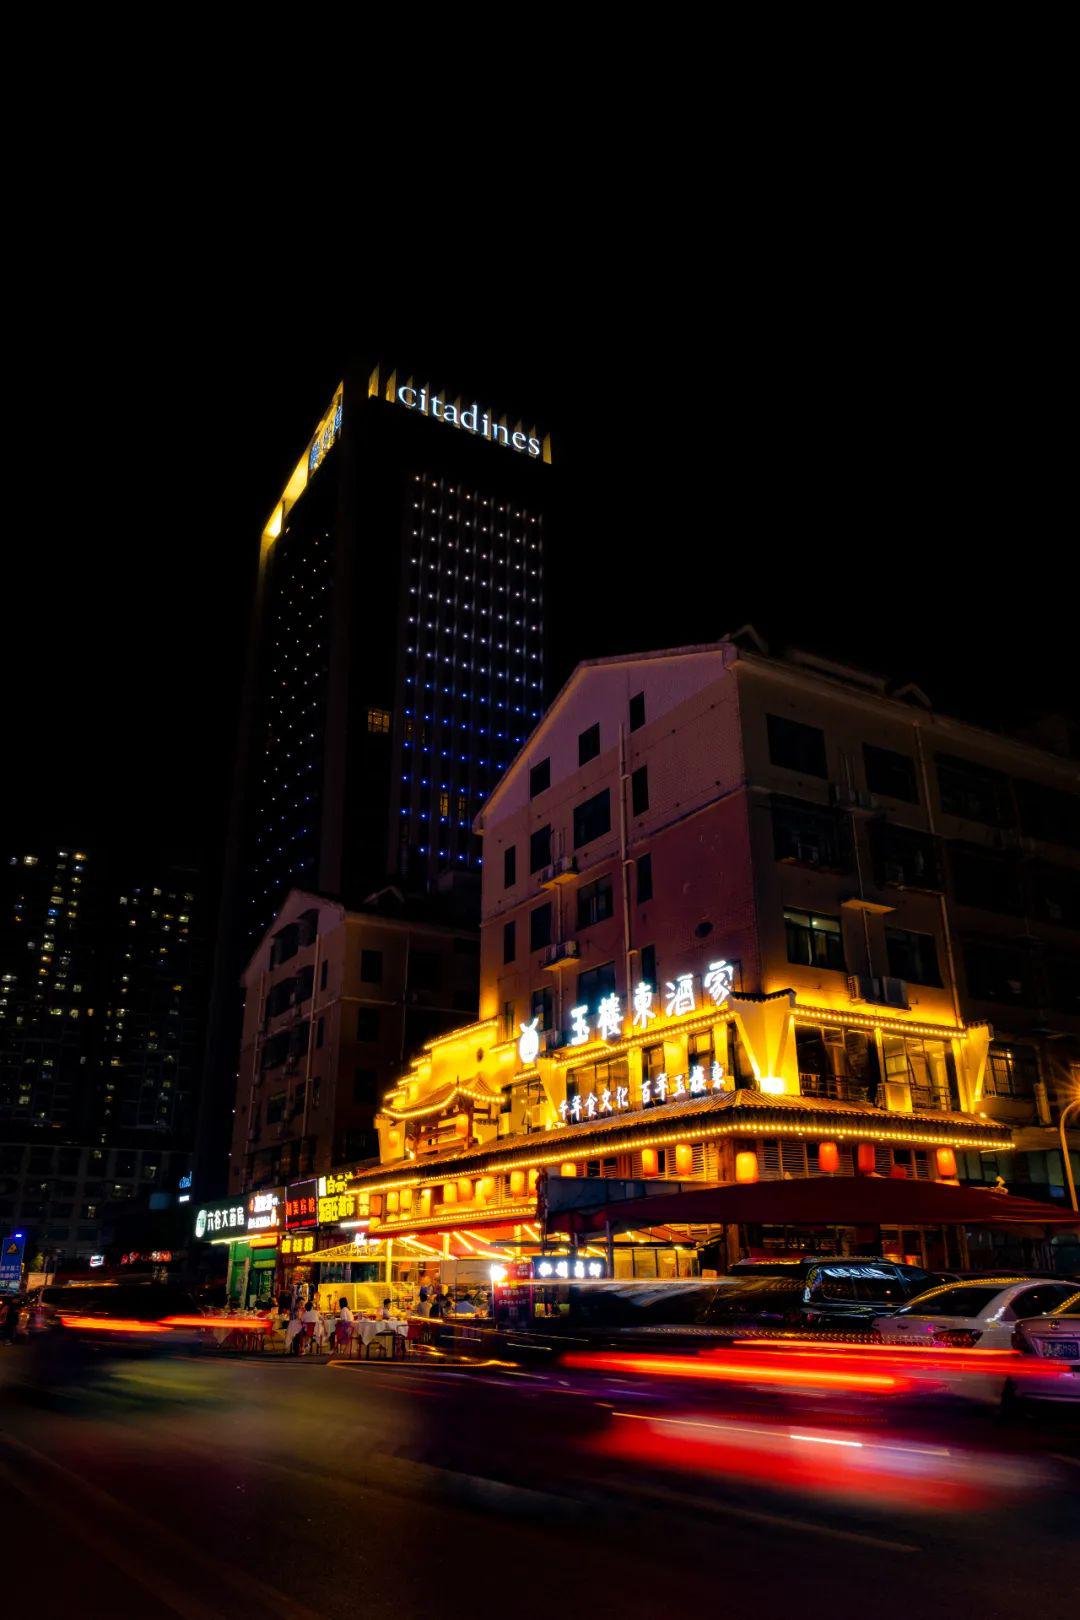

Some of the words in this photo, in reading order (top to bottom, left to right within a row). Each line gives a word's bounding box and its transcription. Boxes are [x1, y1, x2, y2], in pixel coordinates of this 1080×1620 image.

[398, 386, 540, 455] citadines
[559, 1086, 629, 1121] 千年食文化
